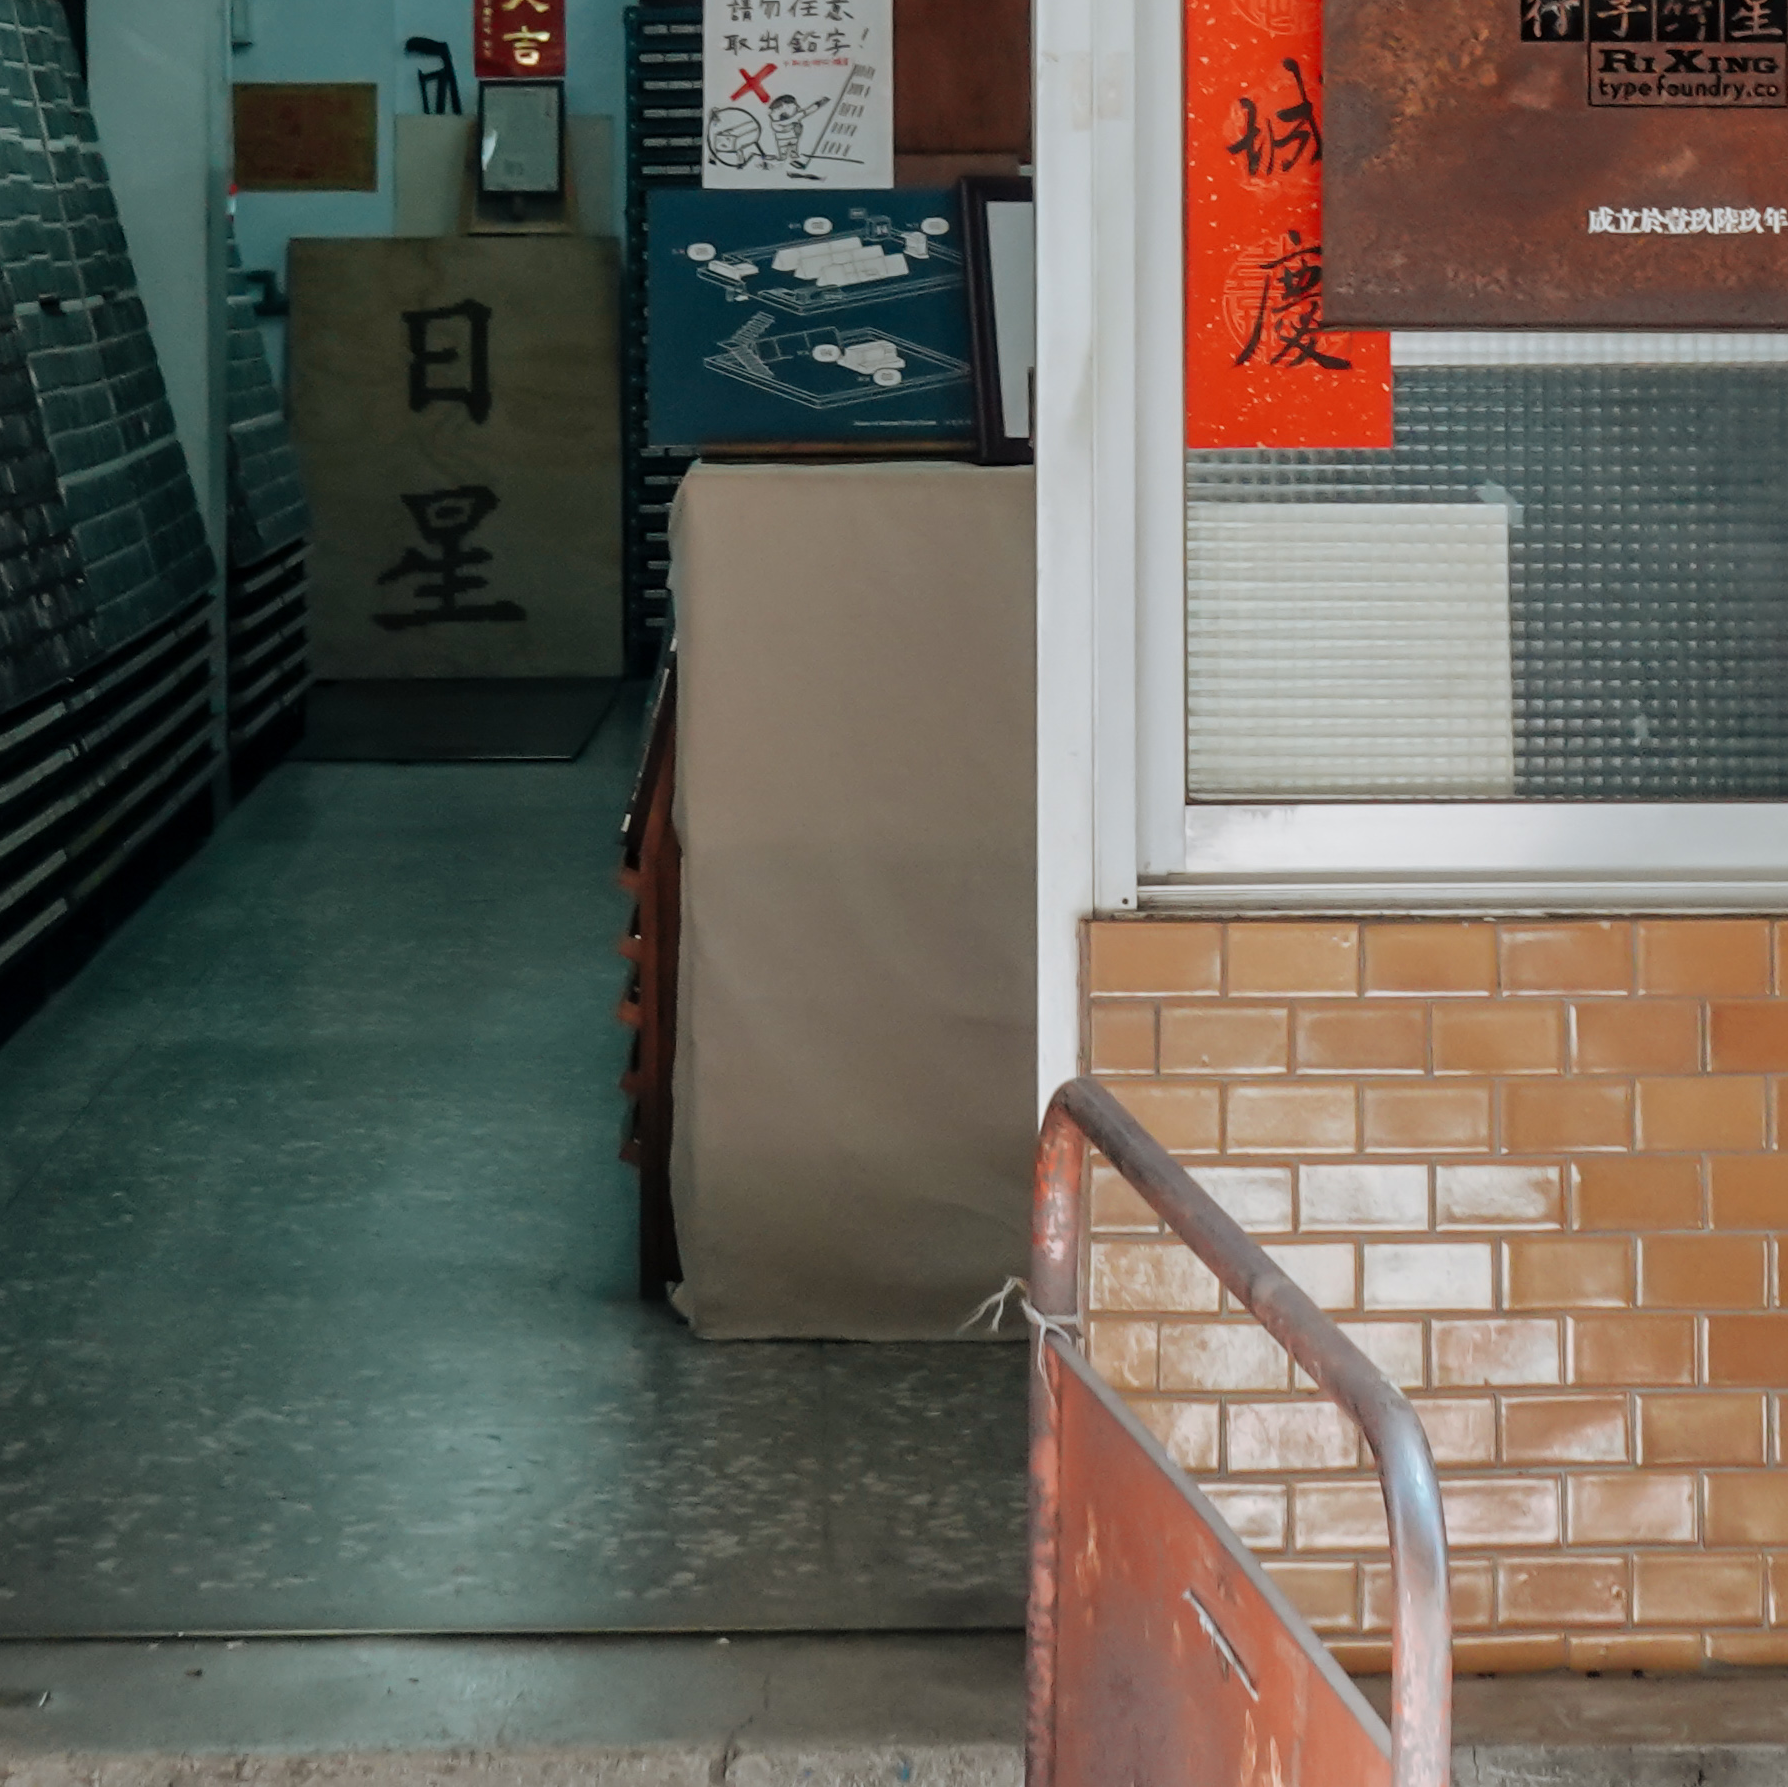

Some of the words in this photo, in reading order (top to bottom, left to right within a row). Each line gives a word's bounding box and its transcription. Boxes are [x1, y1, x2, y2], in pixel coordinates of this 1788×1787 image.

[1588, 205, 1788, 235] 成立於壹玖陸玖年
[371, 298, 526, 631] 日星
